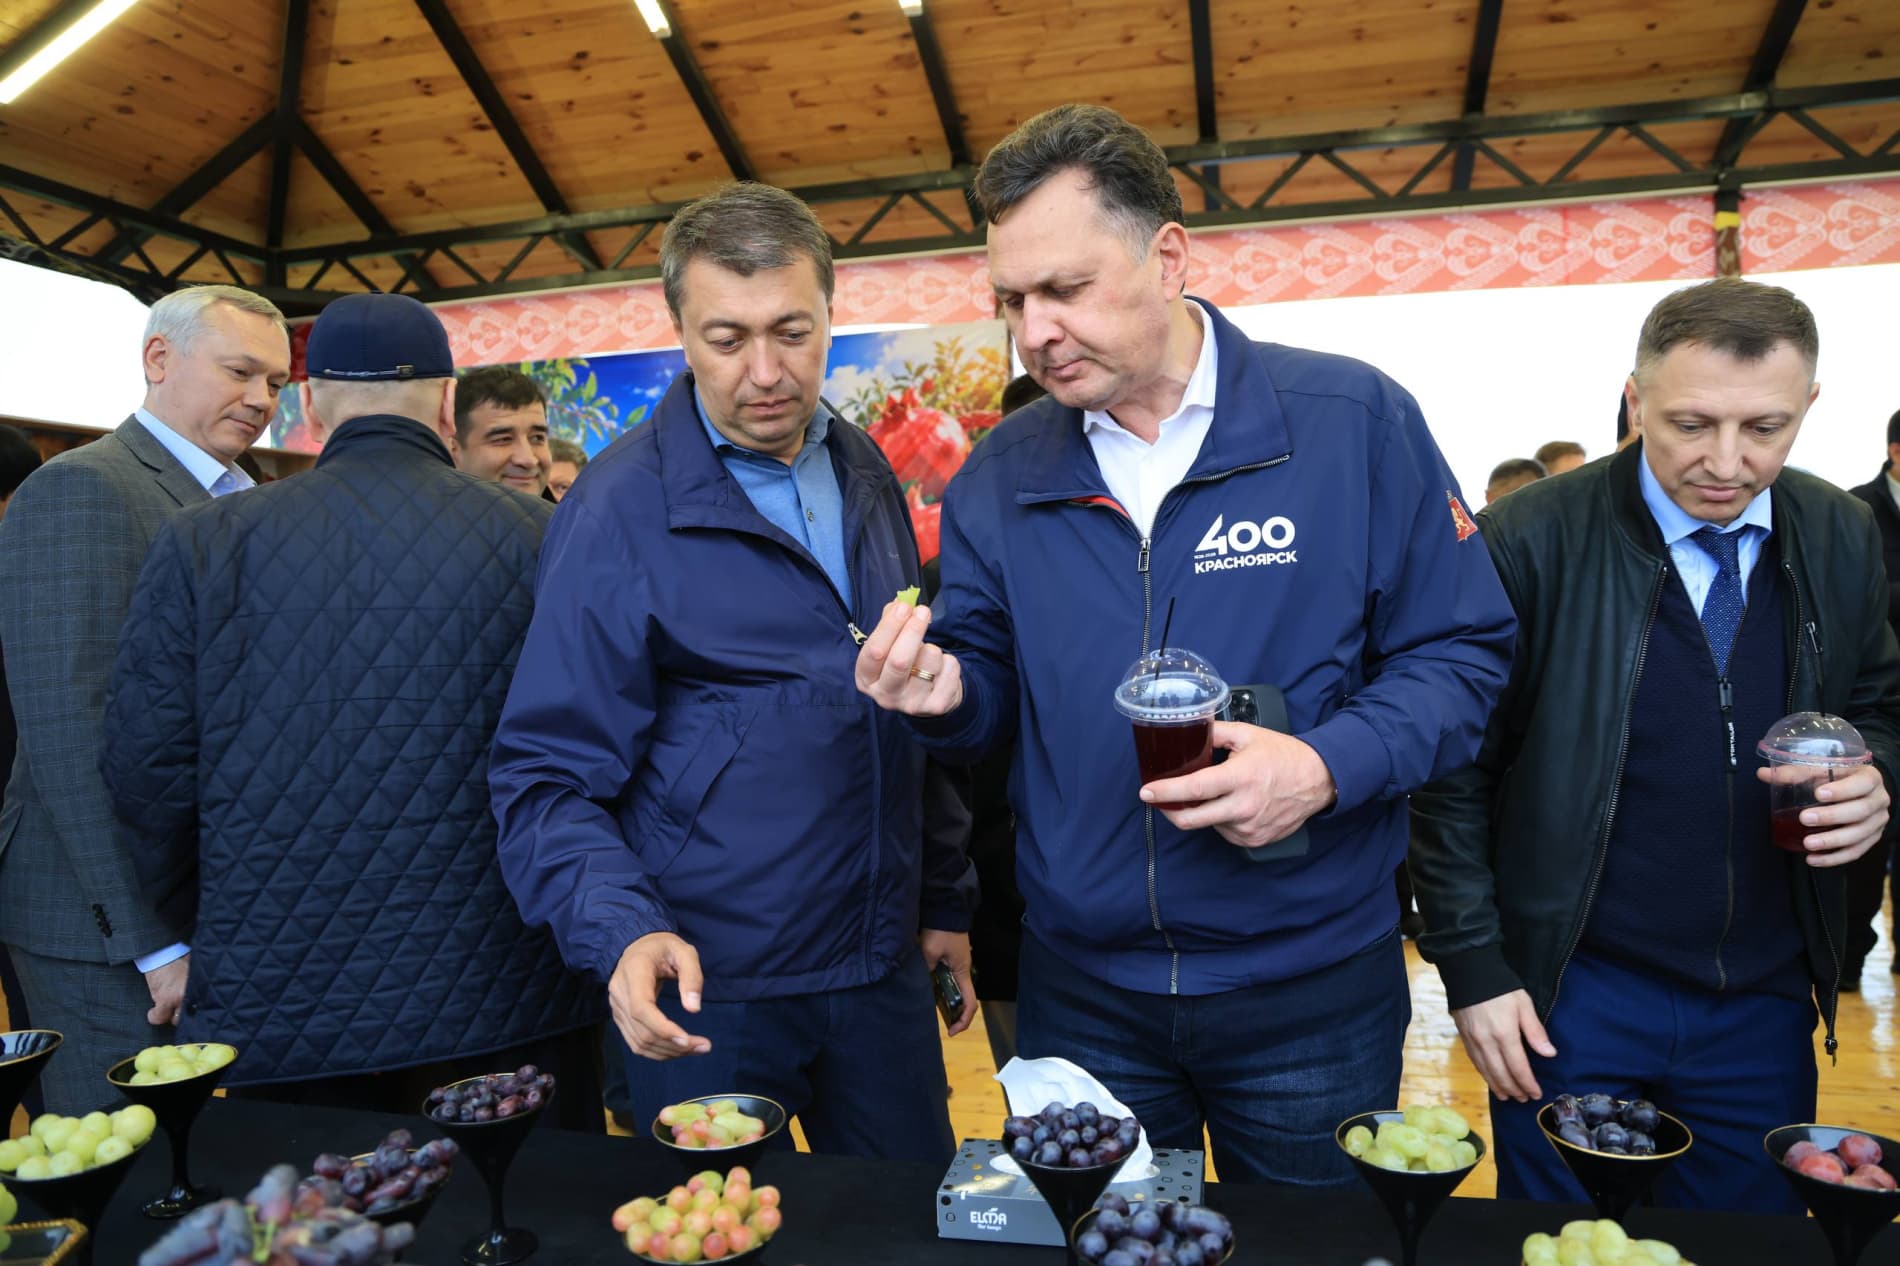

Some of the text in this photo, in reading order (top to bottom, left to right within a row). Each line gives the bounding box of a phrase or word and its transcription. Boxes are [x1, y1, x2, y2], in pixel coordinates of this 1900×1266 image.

[1195, 513, 1296, 555] 400
[1194, 550, 1298, 575] КРАСНОЯРСК
[970, 1209, 1007, 1226] ELMA
